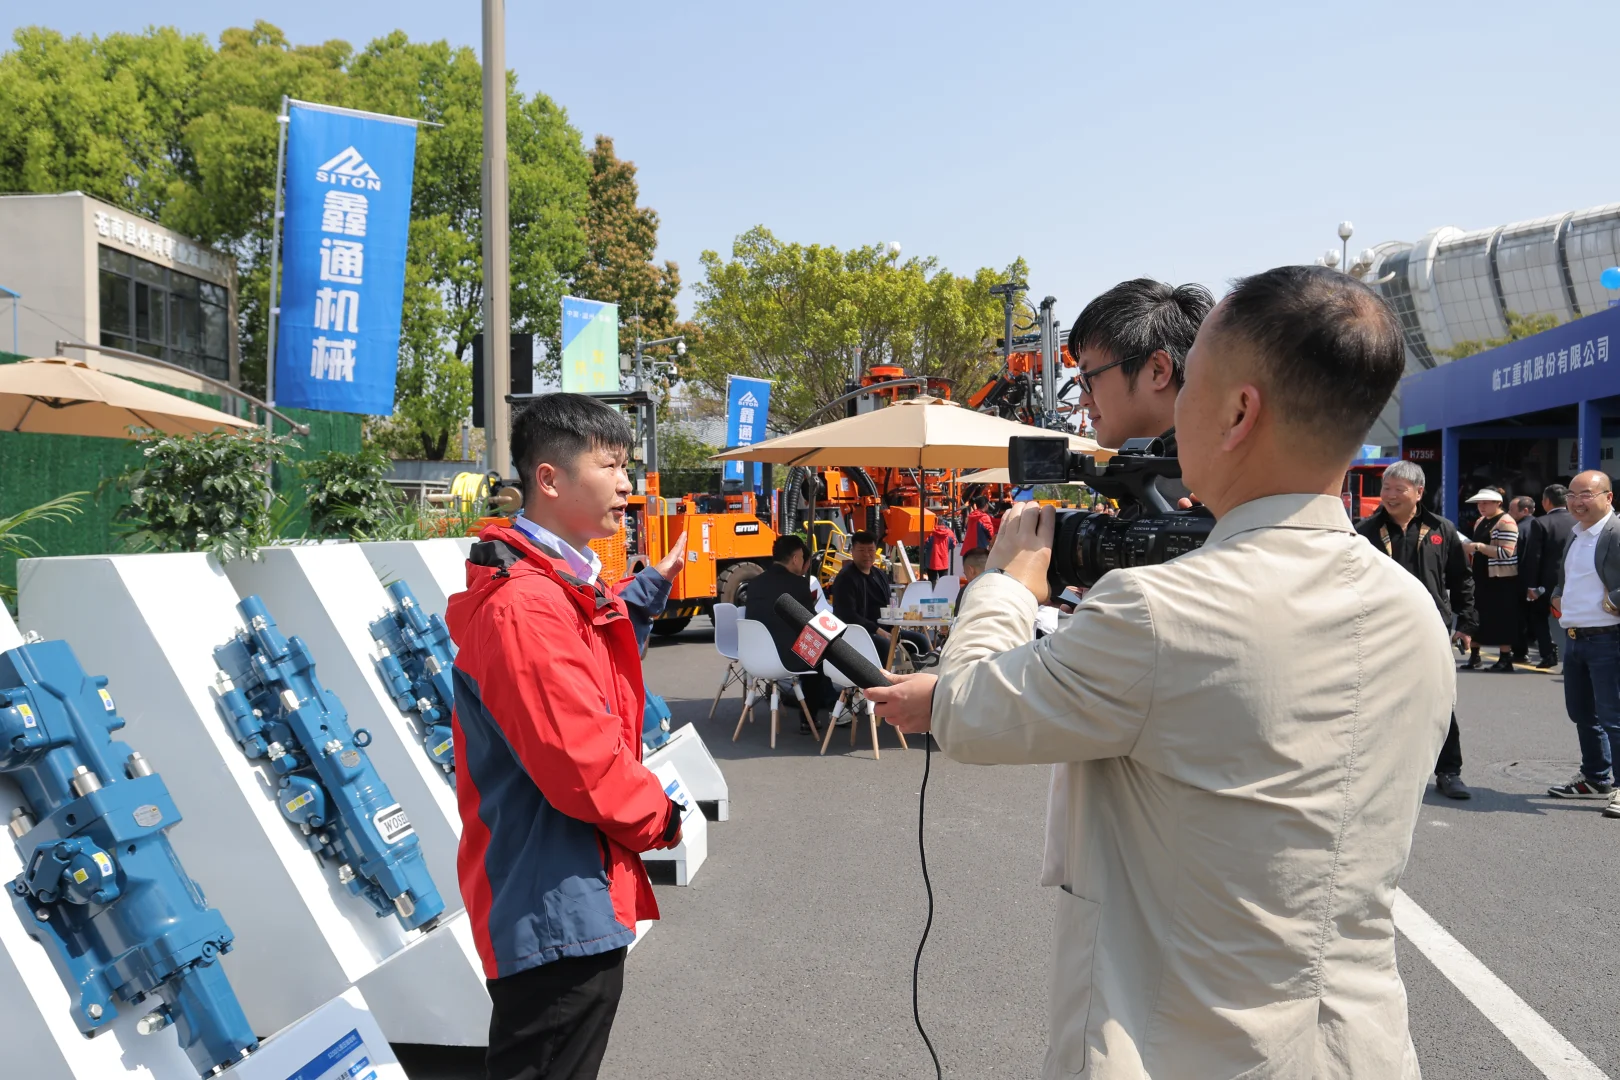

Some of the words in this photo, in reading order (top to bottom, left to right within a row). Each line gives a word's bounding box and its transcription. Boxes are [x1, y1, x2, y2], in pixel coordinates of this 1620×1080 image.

[316, 171, 381, 191] SITON
[310, 189, 368, 383] 鑫通机械
[1492, 335, 1609, 392] 临工重机股份有限公司
[1410, 450, 1434, 459] H735F
[735, 524, 759, 533] SITON
